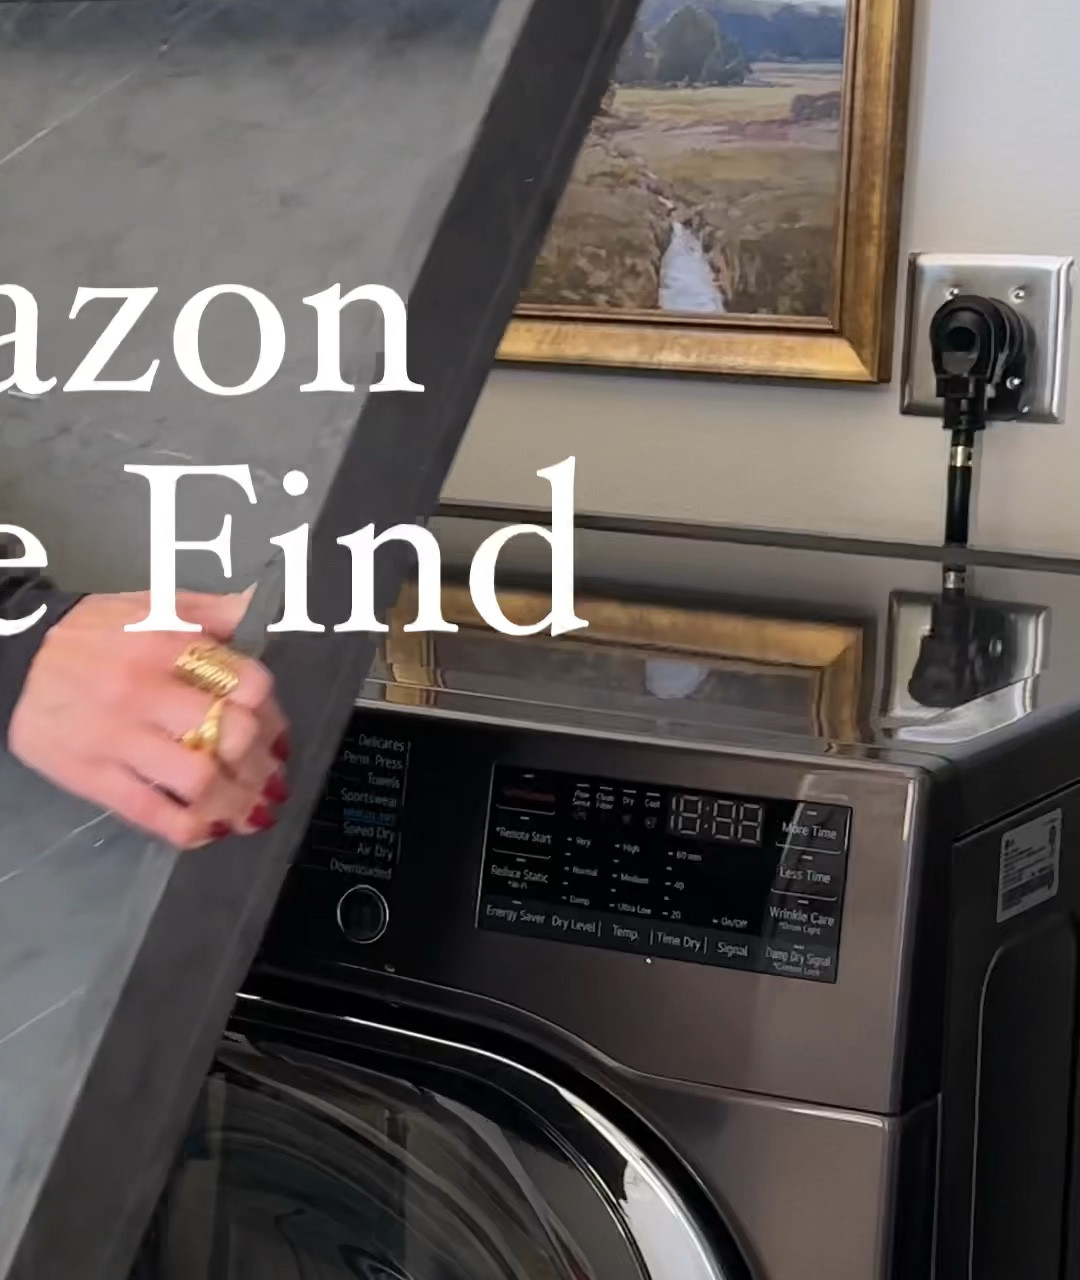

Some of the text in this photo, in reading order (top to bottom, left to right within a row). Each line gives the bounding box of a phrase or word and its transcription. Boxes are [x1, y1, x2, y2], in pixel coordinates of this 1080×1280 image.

[810, 825, 837, 840] Time
[779, 867, 832, 885] Less Time
[486, 904, 546, 926] Energy Saver
[551, 915, 596, 934] Dry Level
[769, 906, 835, 926] Wrinkle Care
[656, 931, 701, 951] Time Dry
[716, 941, 748, 958] Signal
